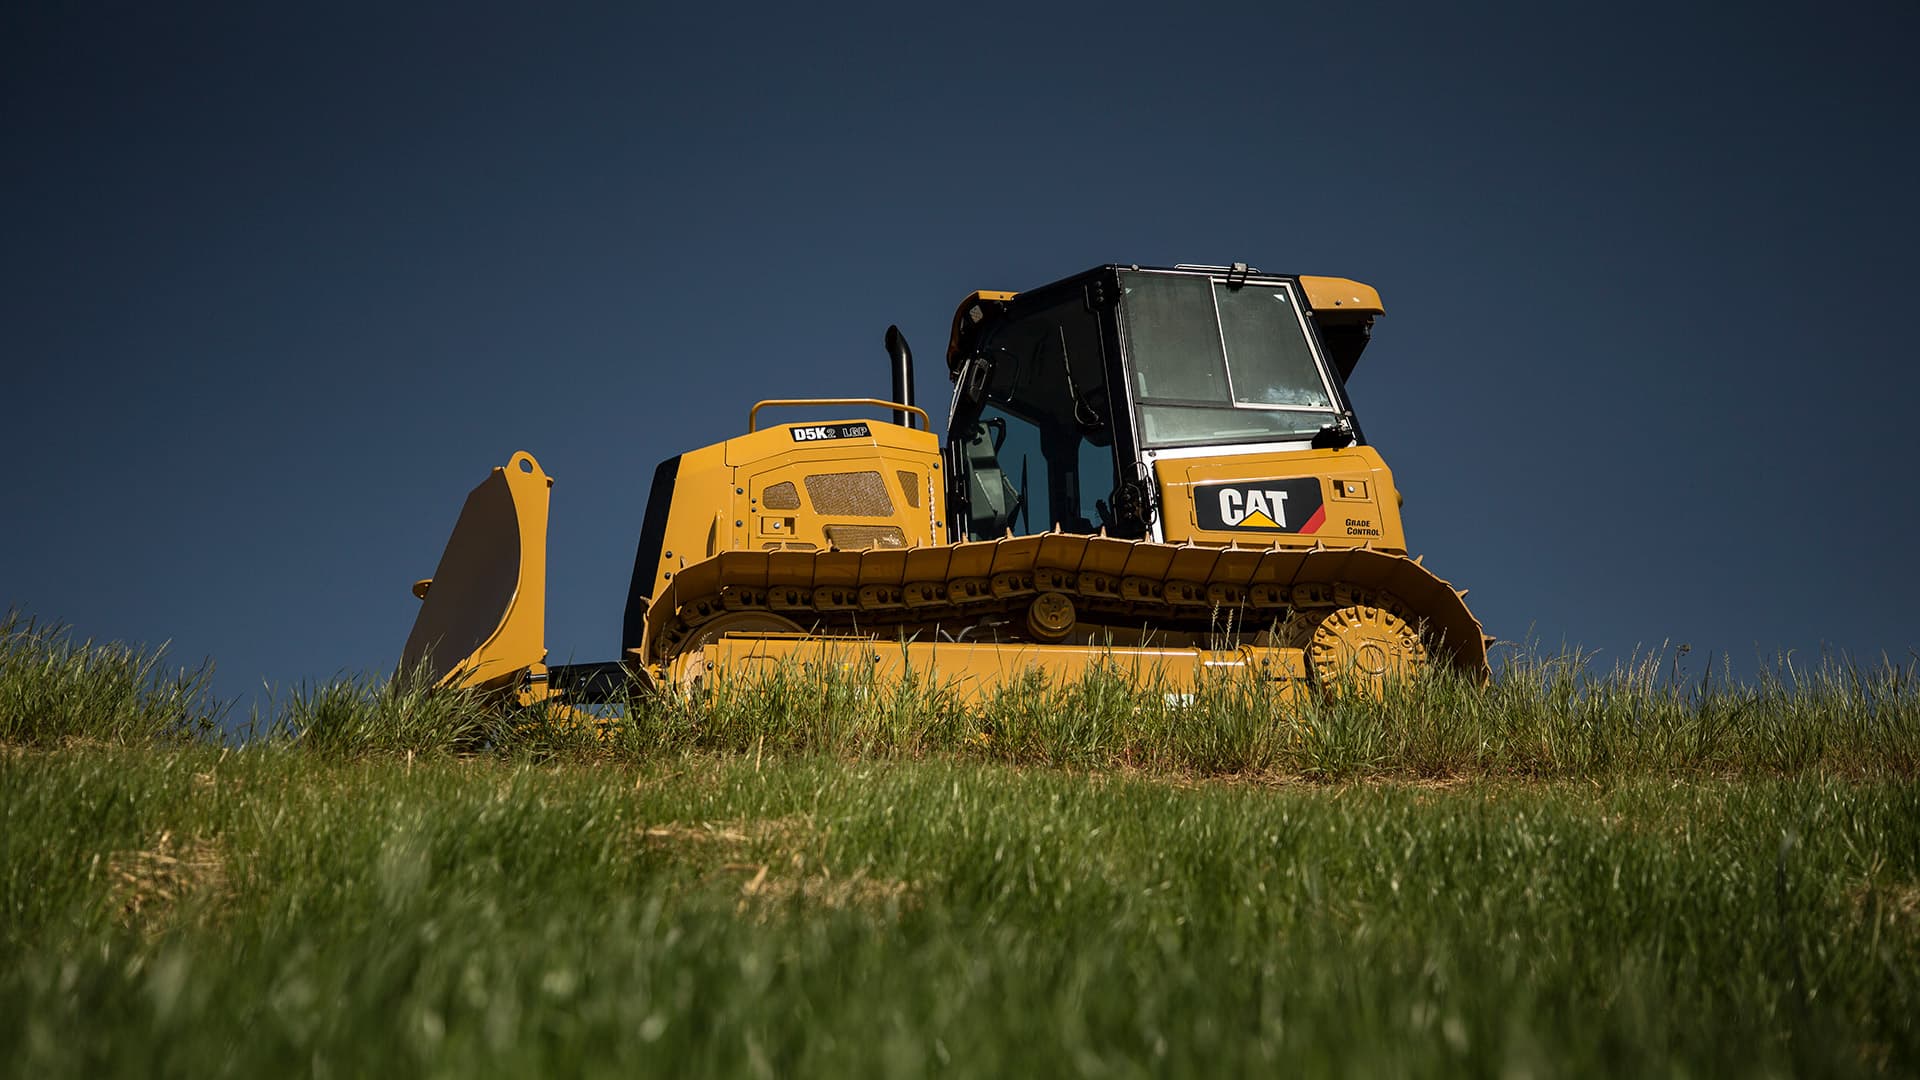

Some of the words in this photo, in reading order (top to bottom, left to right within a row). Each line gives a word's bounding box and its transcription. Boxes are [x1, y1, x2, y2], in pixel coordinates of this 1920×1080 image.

[794, 427, 836, 441] D5K2
[842, 426, 868, 438] LGP
[1218, 488, 1289, 528] CAT
